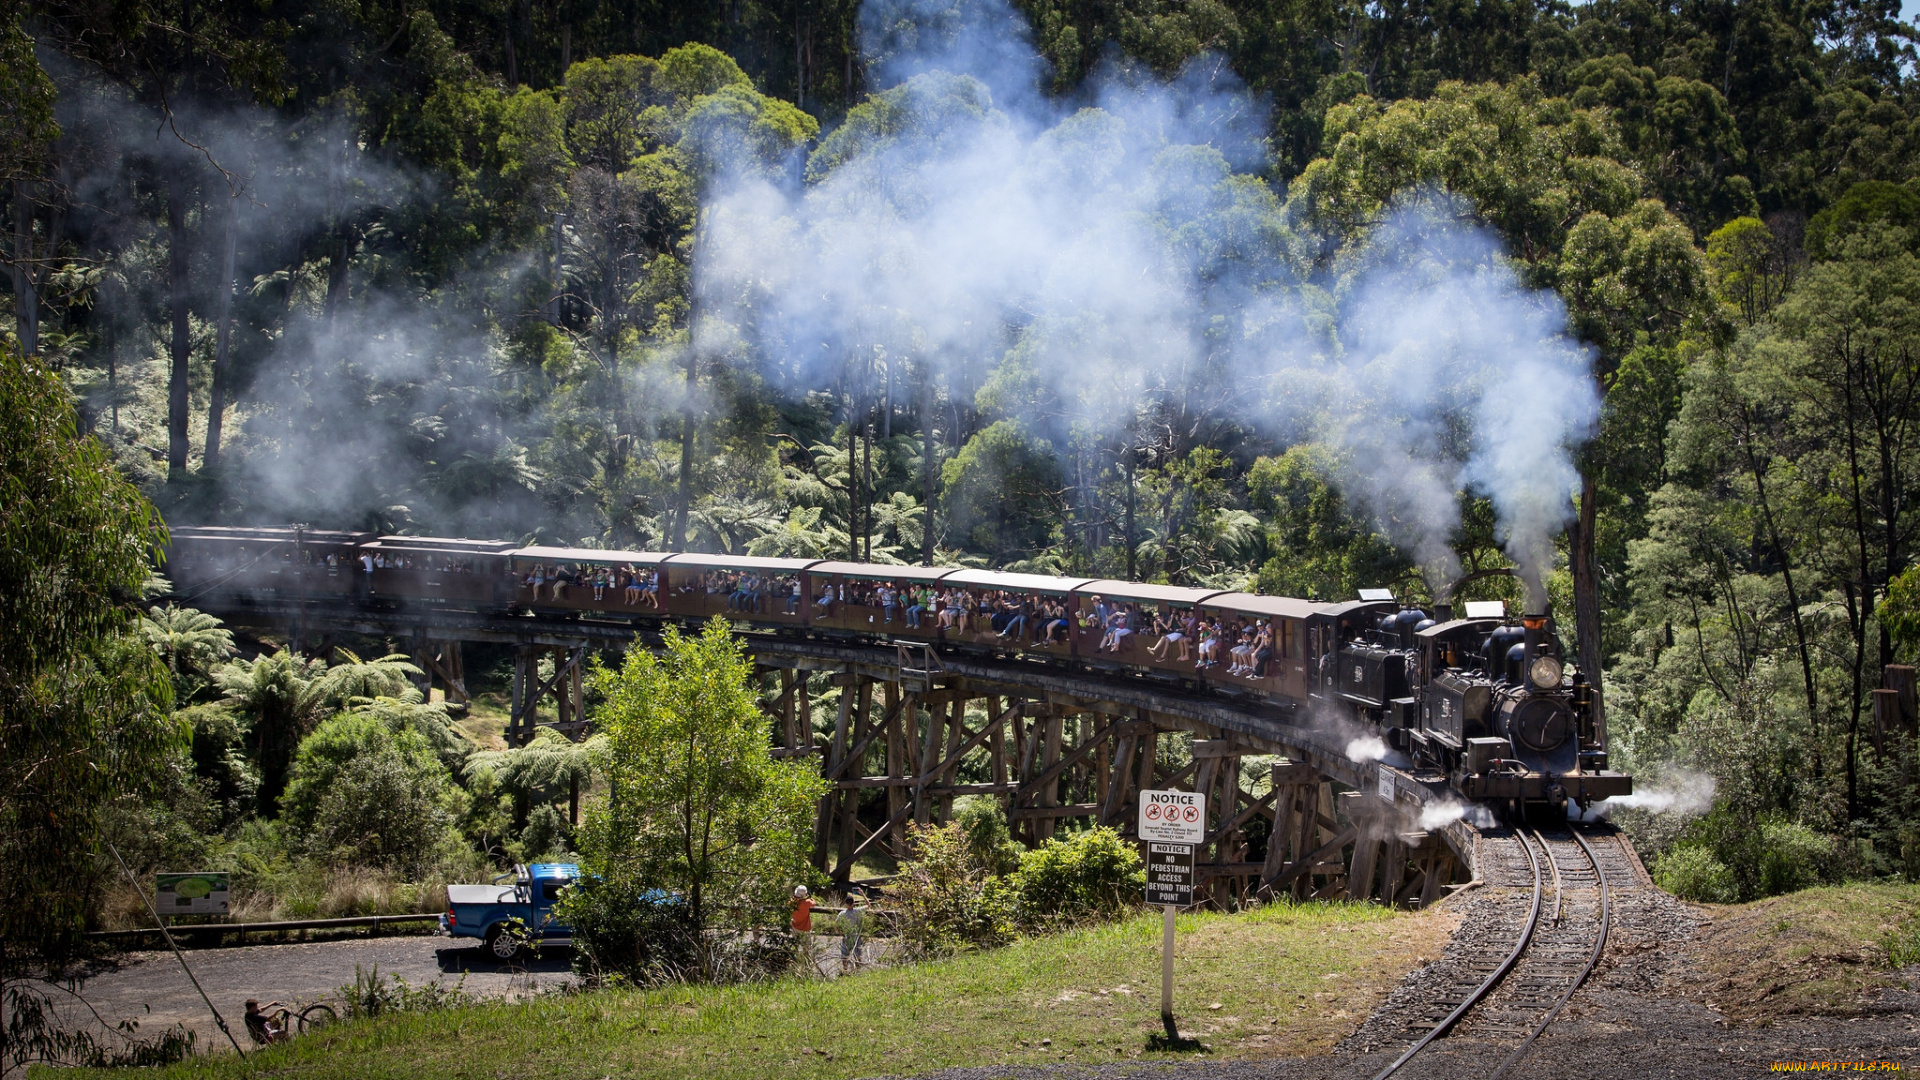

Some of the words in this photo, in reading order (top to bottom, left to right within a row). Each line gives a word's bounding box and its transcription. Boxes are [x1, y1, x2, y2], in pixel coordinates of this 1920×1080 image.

[1151, 794, 1194, 805] NOTICE
[1156, 845, 1186, 853] NOTICE
[1166, 855, 1175, 863] NO
[1151, 864, 1190, 874] PEDESTRIAN
[1158, 873, 1182, 882] ACCESS
[1149, 882, 1173, 891] BEYOND
[1176, 884, 1190, 893] THIS
[1159, 892, 1179, 901] POINT
